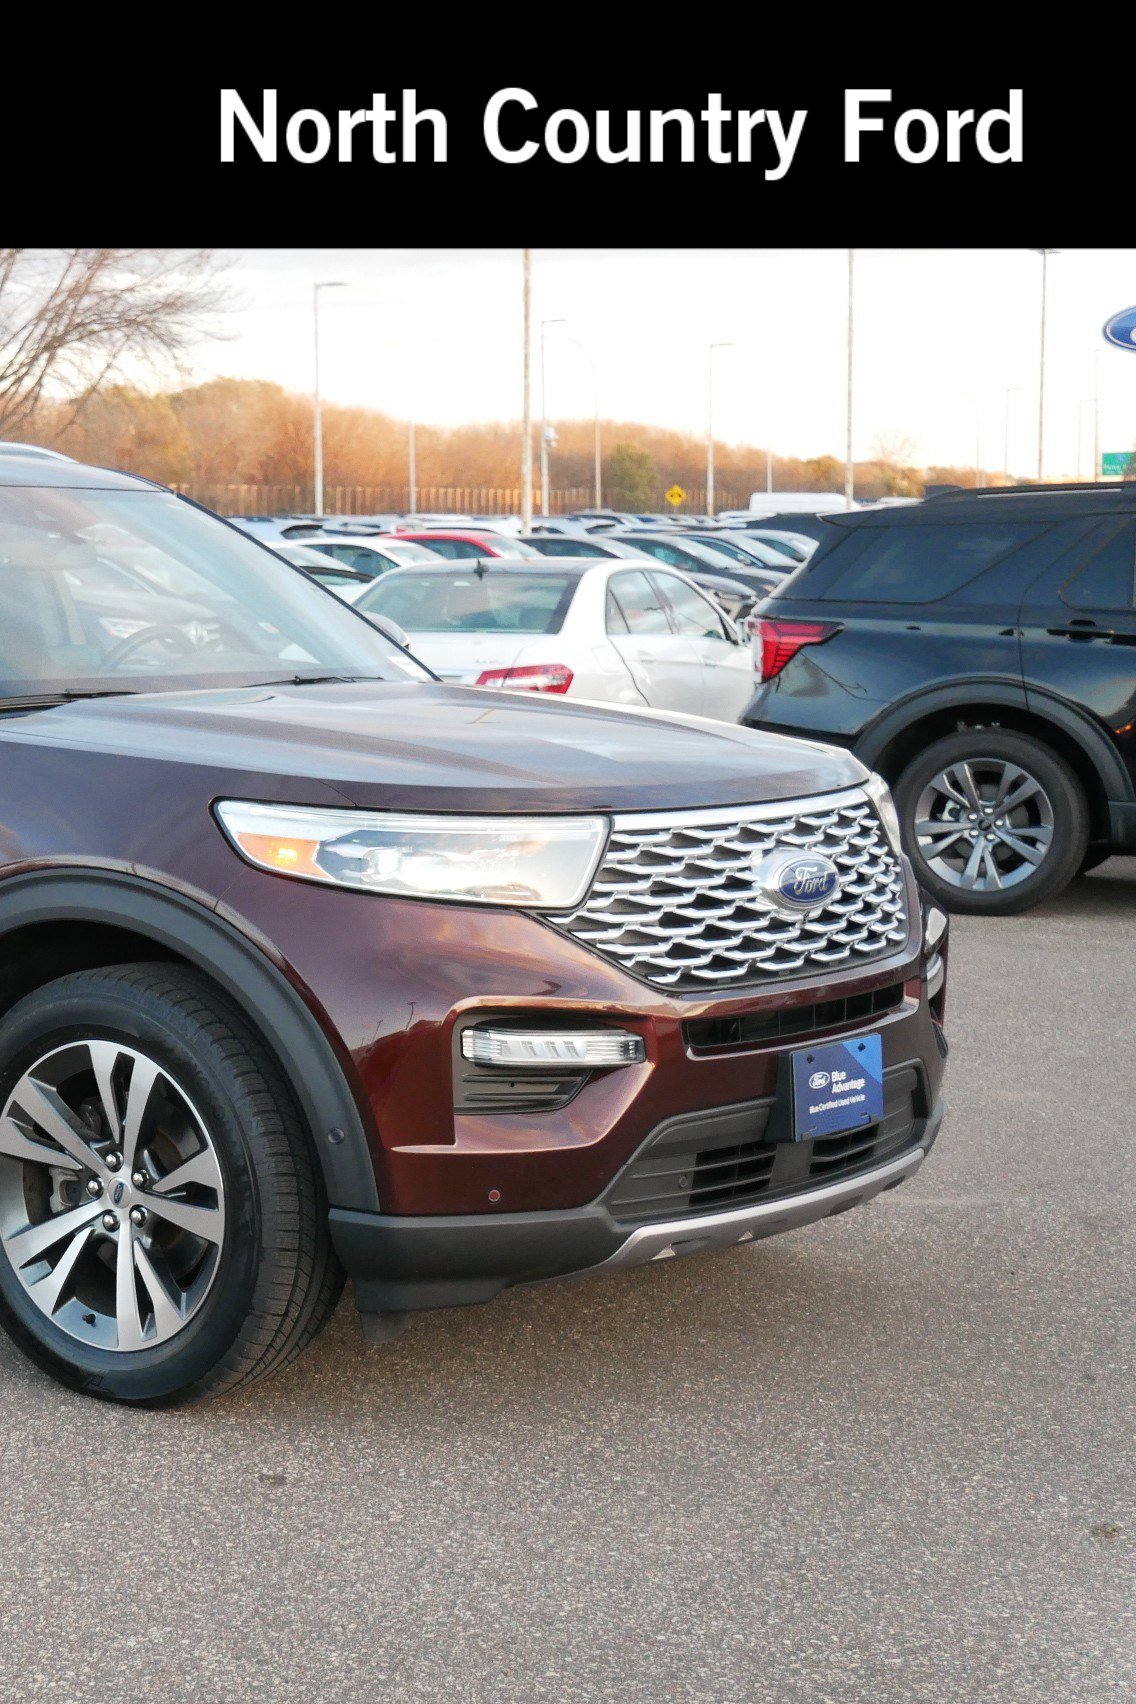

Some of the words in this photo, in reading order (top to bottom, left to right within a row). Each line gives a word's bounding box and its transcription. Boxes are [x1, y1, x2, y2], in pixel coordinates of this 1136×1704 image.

[793, 866, 828, 896] Ford
[831, 1070, 846, 1082] Blue
[831, 1078, 865, 1094] Advantage
